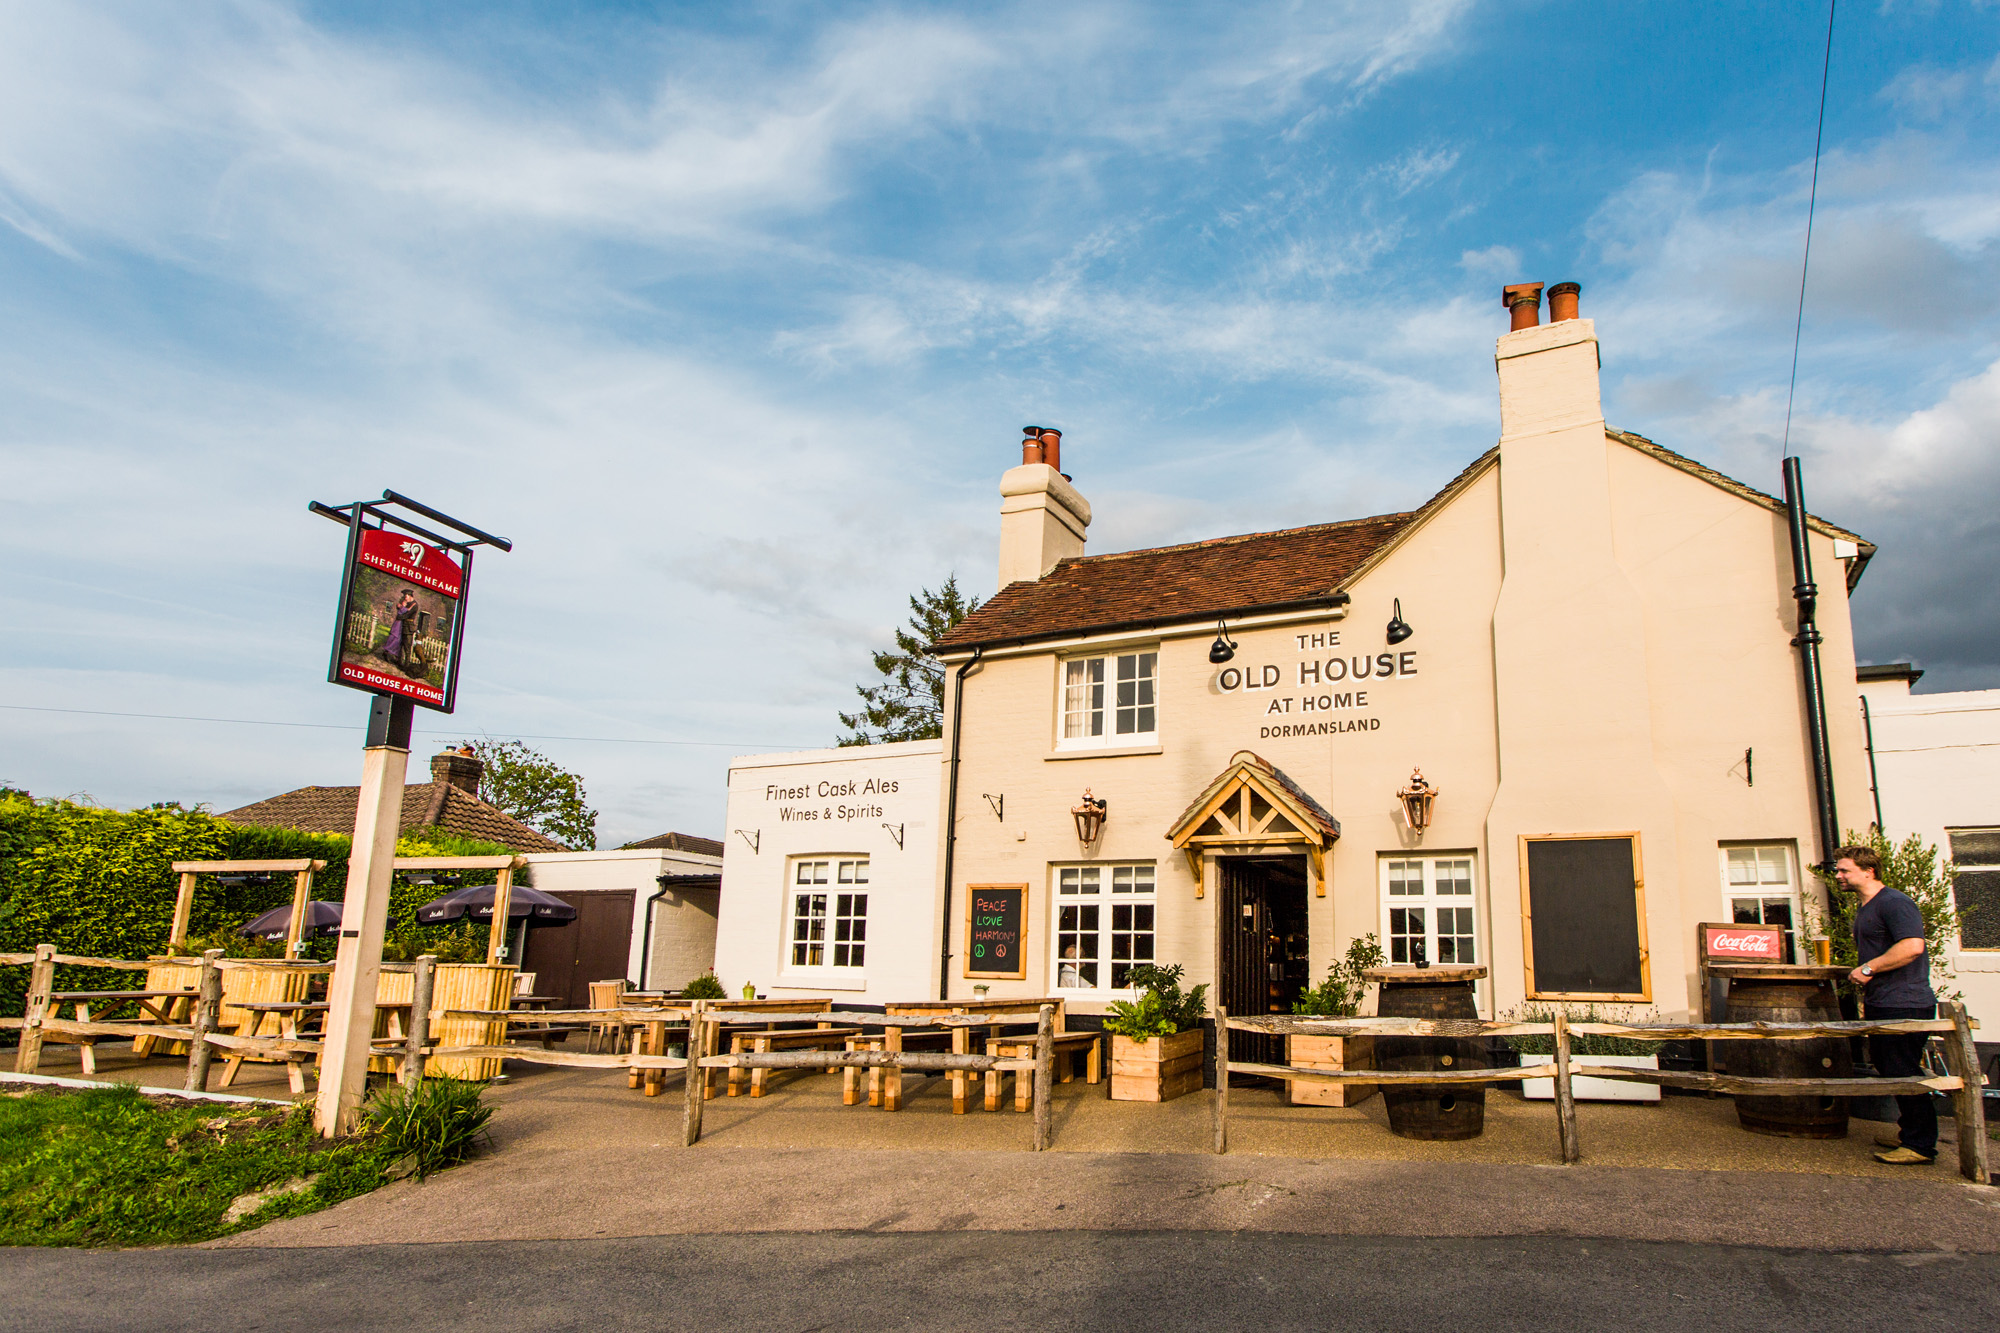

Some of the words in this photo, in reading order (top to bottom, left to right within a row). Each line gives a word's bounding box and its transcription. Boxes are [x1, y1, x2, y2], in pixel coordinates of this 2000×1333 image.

[364, 552, 422, 580] SHEPHERD
[424, 575, 459, 595] NEAME
[1295, 631, 1341, 651] THE
[1218, 665, 1280, 692] OLD
[1299, 651, 1418, 686] HOUSE
[343, 667, 365, 679] OLD
[367, 673, 401, 690] HOUSE
[402, 683, 415, 693] AT
[416, 687, 443, 701] HOME
[1266, 697, 1293, 715] AT
[1302, 691, 1369, 712] HOME
[1260, 718, 1381, 739] DORMANSLAND
[766, 784, 811, 801] Finest
[817, 780, 857, 798] Cask
[863, 778, 899, 795] Ales
[779, 807, 818, 822] Wines
[823, 806, 832, 820] &
[837, 804, 883, 822] Spirits
[976, 898, 1007, 912] PEACE
[976, 915, 1003, 926] LOVE
[975, 930, 1016, 944] HARMONY
[1713, 933, 1771, 952] Coca-Cola
